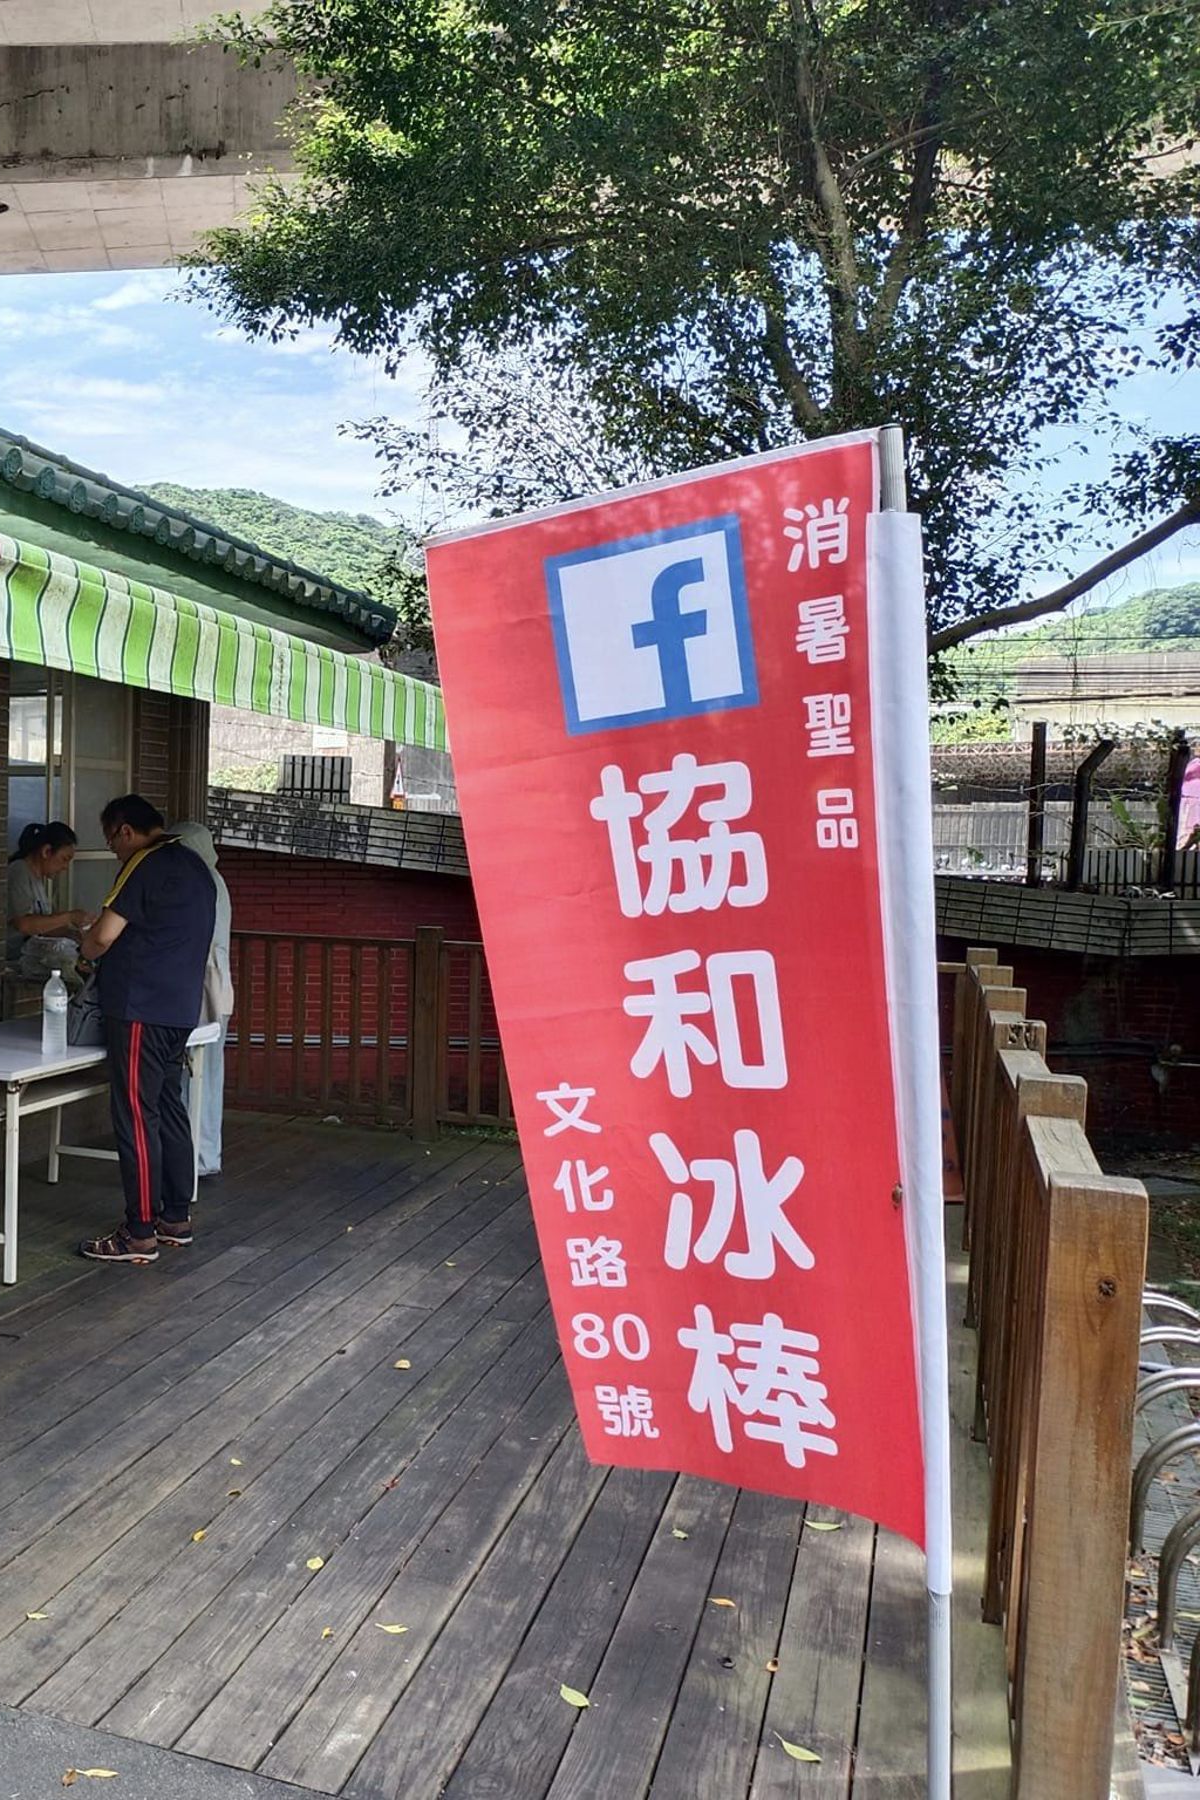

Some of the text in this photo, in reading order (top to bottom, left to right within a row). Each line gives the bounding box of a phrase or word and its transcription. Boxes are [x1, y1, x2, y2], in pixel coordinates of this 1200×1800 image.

[784, 497, 859, 848] 消暑聖品
[535, 1082, 660, 1440] 文化路80號
[590, 754, 838, 1469] 協和冰棒
